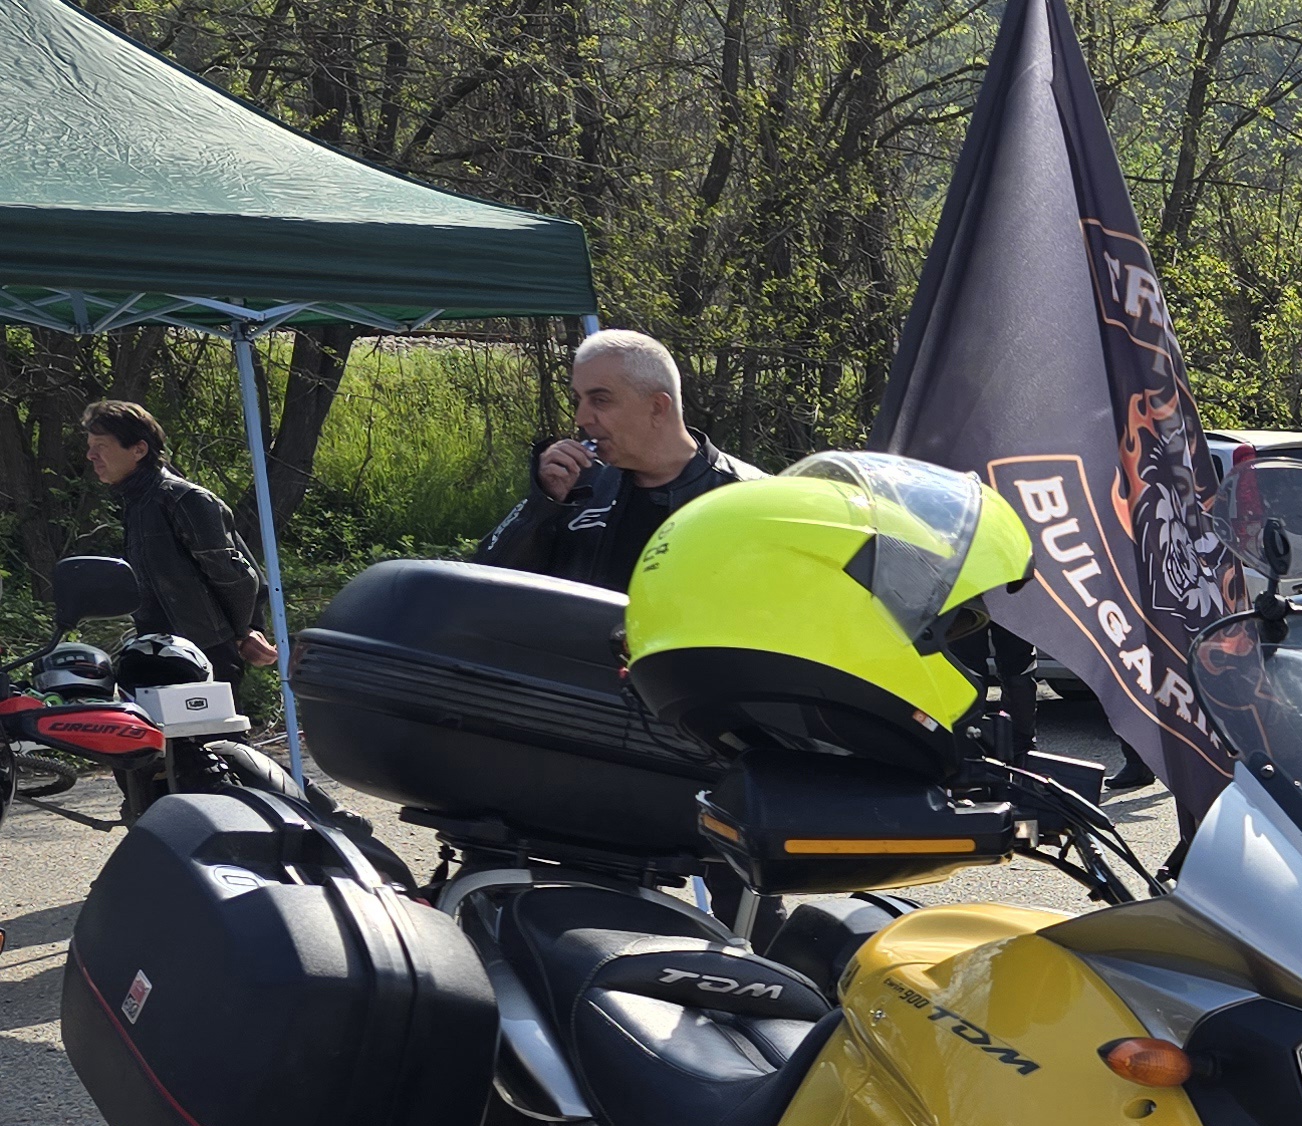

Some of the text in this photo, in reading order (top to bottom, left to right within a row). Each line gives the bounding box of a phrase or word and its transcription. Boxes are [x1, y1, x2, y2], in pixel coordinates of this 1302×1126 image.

[1014, 476, 1223, 750] BULGARI
[48, 722, 119, 734] CIRCUIT
[659, 968, 784, 1000] TDM
[927, 1005, 1040, 1075] TDM
